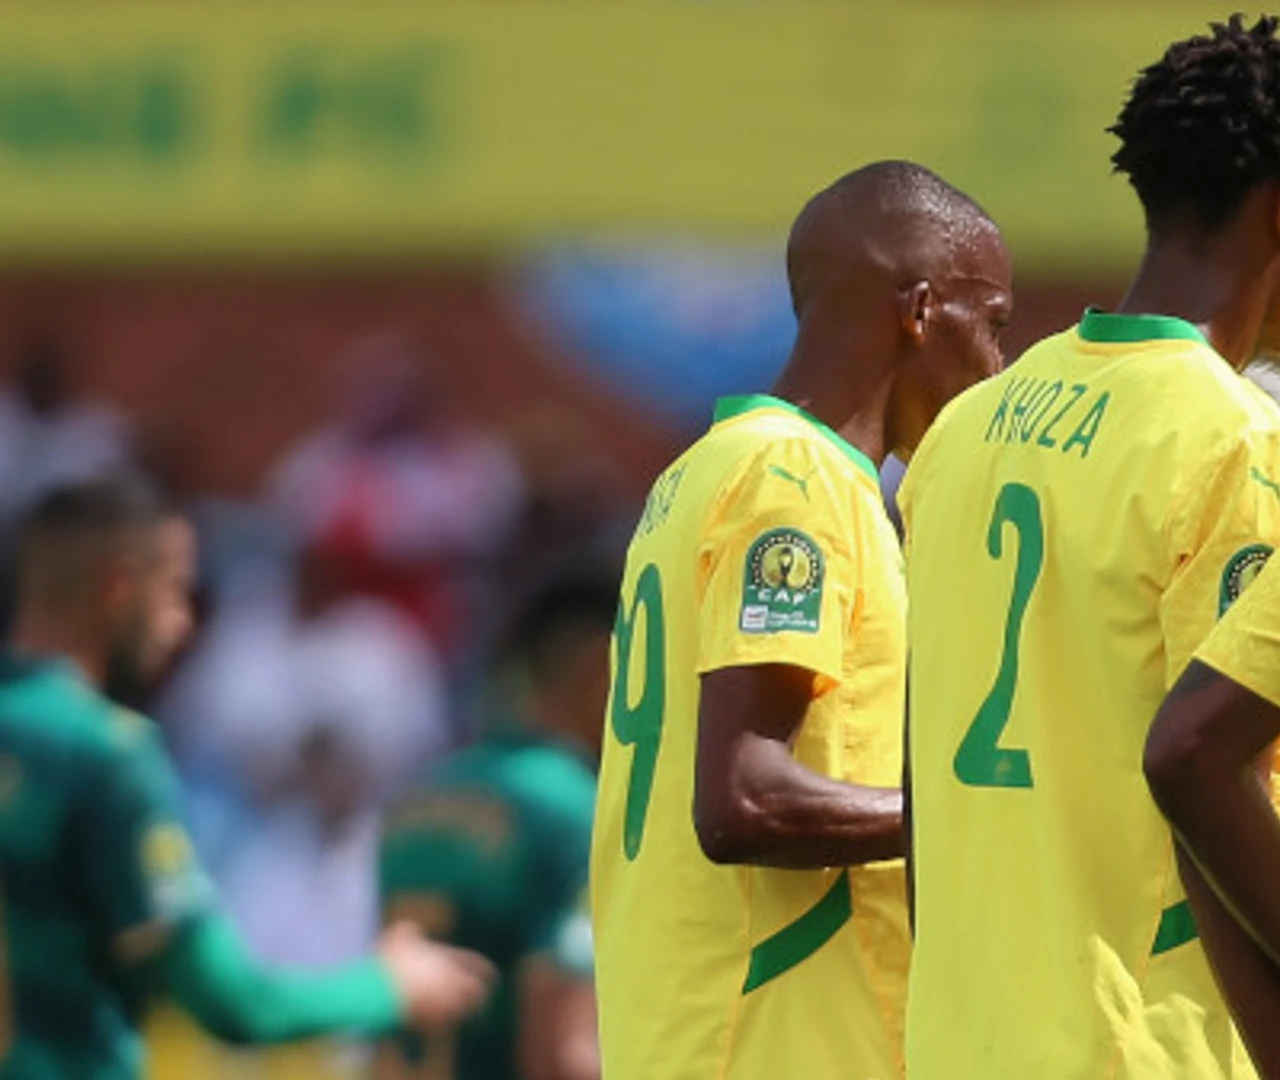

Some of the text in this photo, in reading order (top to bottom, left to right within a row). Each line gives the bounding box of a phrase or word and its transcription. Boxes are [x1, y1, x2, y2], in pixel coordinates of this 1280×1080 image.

[986, 375, 1111, 458] KHOZA
[757, 587, 806, 606] CAF
[953, 483, 1044, 788] 2
